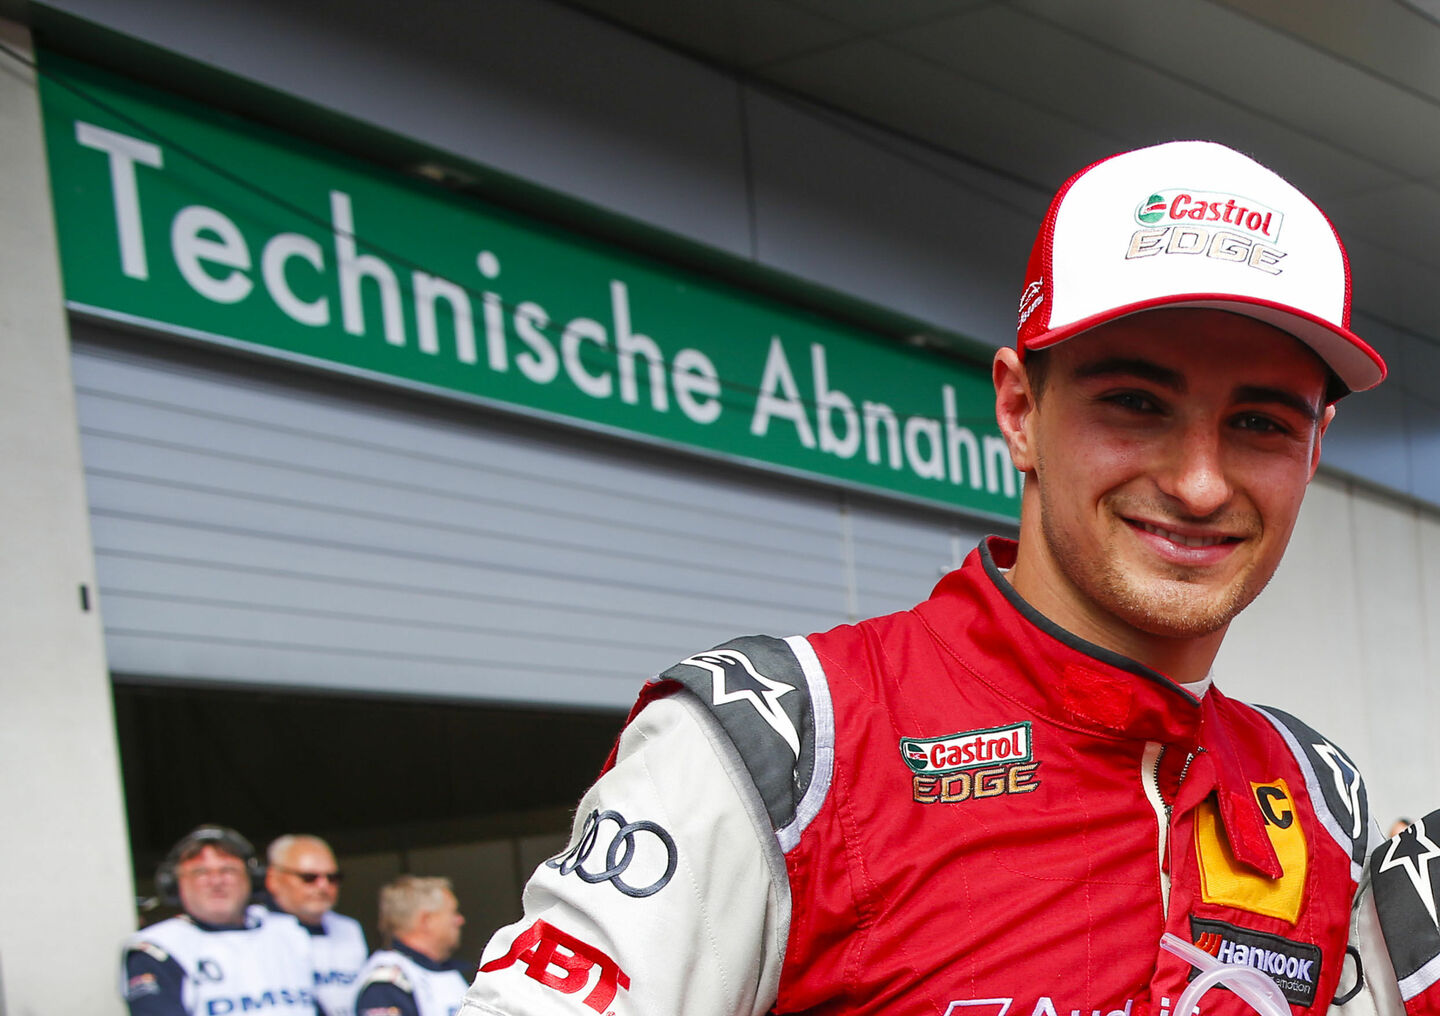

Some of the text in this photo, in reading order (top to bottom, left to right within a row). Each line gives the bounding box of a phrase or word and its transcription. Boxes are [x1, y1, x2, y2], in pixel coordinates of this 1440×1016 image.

[1169, 193, 1273, 237] Castrol
[75, 120, 722, 425] Technische
[1125, 226, 1288, 276] EDGE
[930, 731, 1023, 769] Castrol
[912, 761, 1043, 804] EDGE
[477, 918, 632, 1016] ABT
